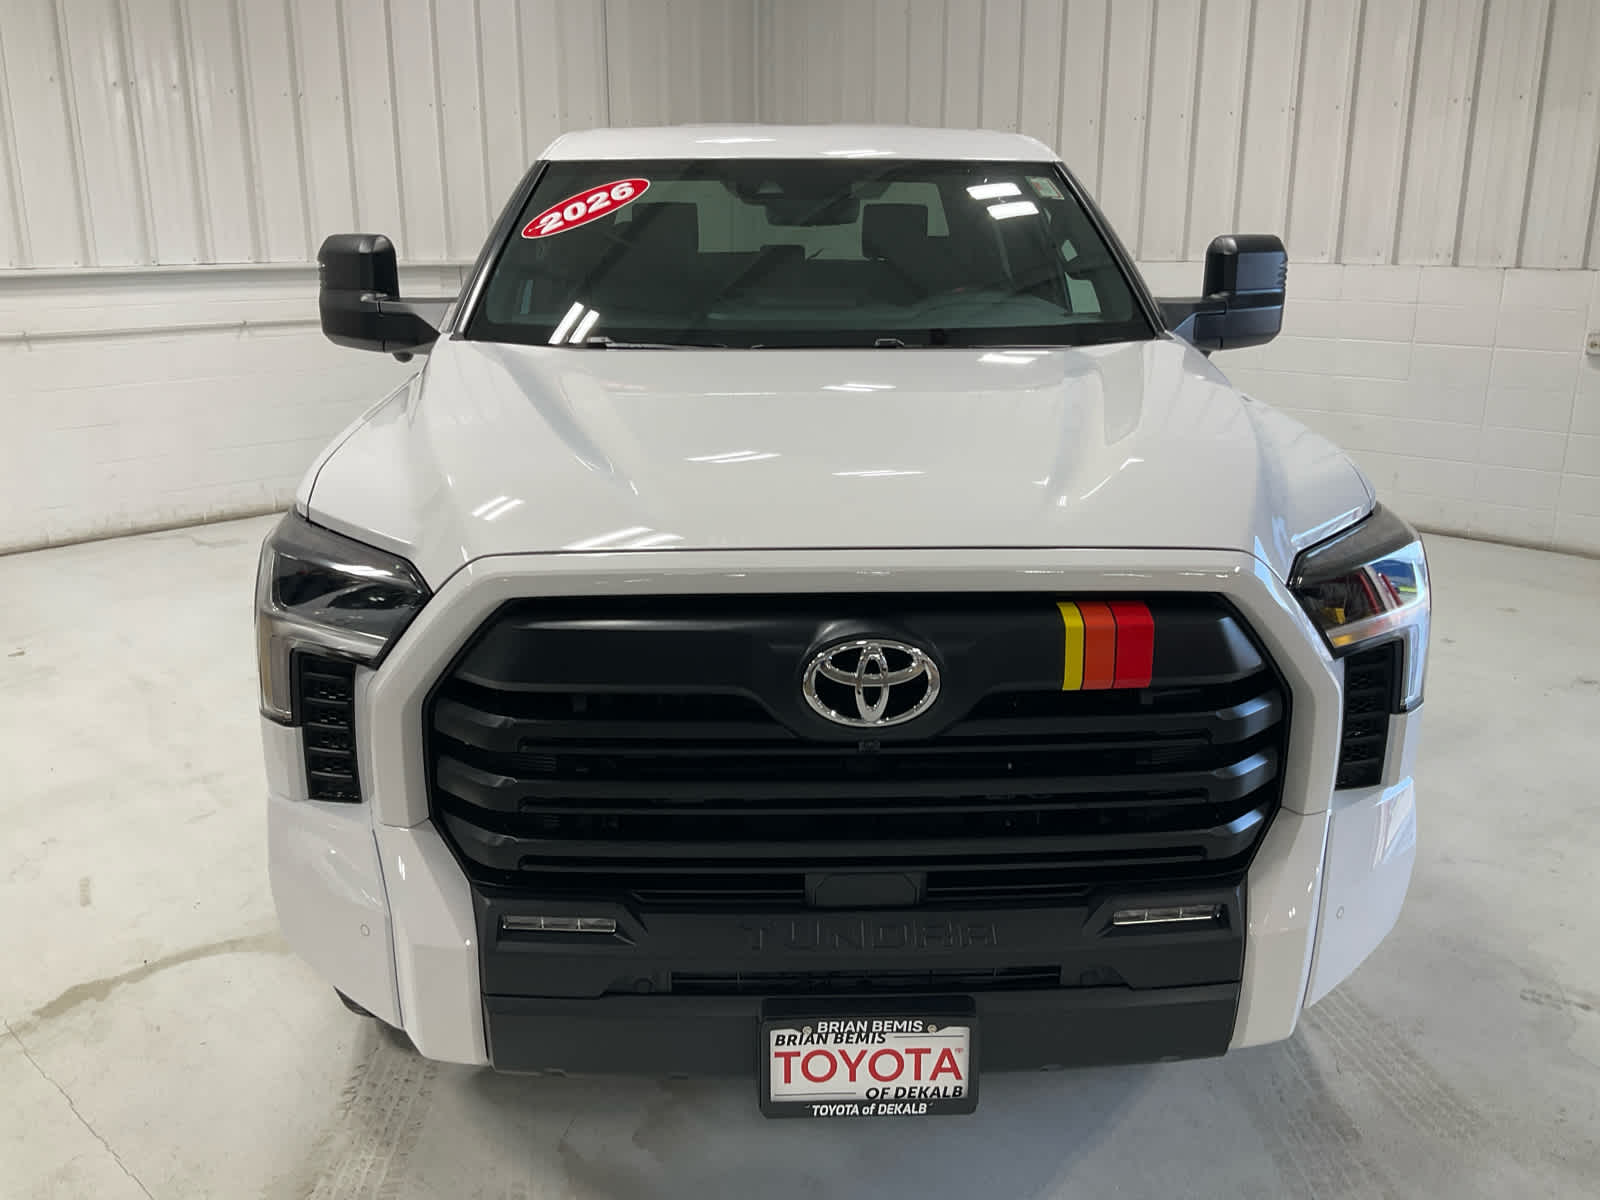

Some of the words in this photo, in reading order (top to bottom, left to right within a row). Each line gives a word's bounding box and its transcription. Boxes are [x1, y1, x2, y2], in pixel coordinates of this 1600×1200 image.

[539, 182, 634, 235] 2026
[739, 918, 1000, 951] TUNDRA
[817, 1021, 867, 1033] BRIAN
[872, 1020, 923, 1032] BEMIS
[775, 1033, 829, 1046] BRIAN
[834, 1033, 886, 1045] BEMIS
[774, 1047, 963, 1084] TOYOTA
[865, 1087, 891, 1100] OF
[895, 1086, 963, 1099] DEKALB
[812, 1104, 859, 1116] TOYOTA
[862, 1104, 876, 1115] of
[879, 1103, 927, 1115] DEKALB
